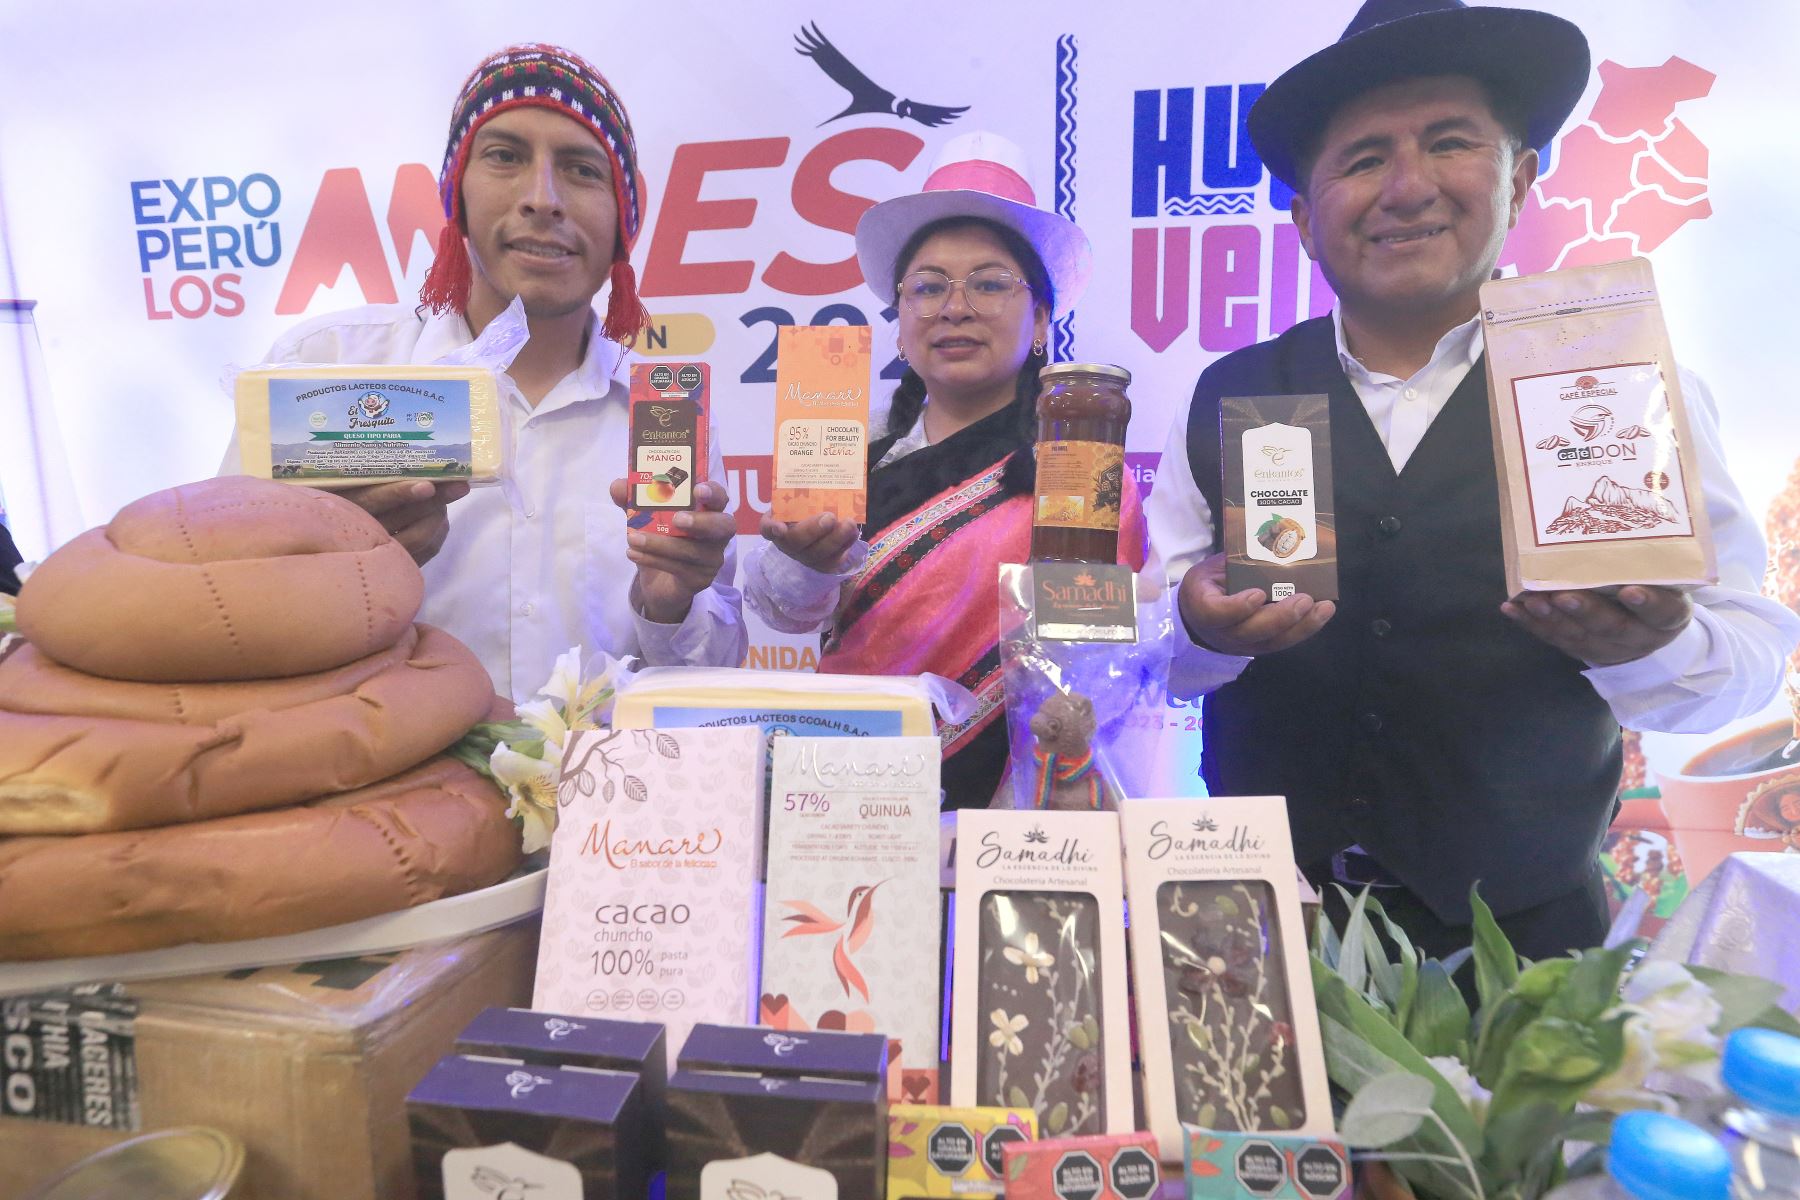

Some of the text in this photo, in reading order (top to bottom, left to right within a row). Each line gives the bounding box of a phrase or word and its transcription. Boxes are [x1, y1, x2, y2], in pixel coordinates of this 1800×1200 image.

[130, 172, 282, 226] EXPO
[275, 126, 926, 316] AES
[137, 219, 283, 273] PERÚ
[143, 273, 246, 321] LOS
[296, 384, 347, 403] PRODUCTOS
[348, 383, 386, 391] LACTEOS
[388, 384, 422, 396] CCOALH
[1581, 388, 1618, 398] ESPECIAL
[347, 405, 358, 416] El
[349, 416, 395, 429] Fresquito
[823, 447, 856, 456] Stevia
[1250, 490, 1308, 498] CHOCOLATE
[1042, 580, 1127, 602] Samadhi
[741, 645, 818, 671] NIDA
[750, 714, 797, 724] LACTEOS
[798, 715, 842, 730] CCOALH
[789, 743, 926, 788] Manari
[784, 792, 912, 820] 57% QUINUA
[580, 818, 724, 870] Manari
[976, 831, 1095, 868] Samadhi
[1148, 820, 1265, 860] Samadhi
[630, 859, 638, 868] El
[640, 859, 661, 868] sabor
[664, 860, 673, 868] de
[675, 860, 682, 868] la
[1222, 866, 1262, 874] Artesanal
[1047, 877, 1088, 886] Artesanal
[595, 904, 691, 925] cacao
[594, 928, 654, 943] chuncho
[591, 948, 688, 977] 100% pasta
[659, 968, 684, 979] pura
